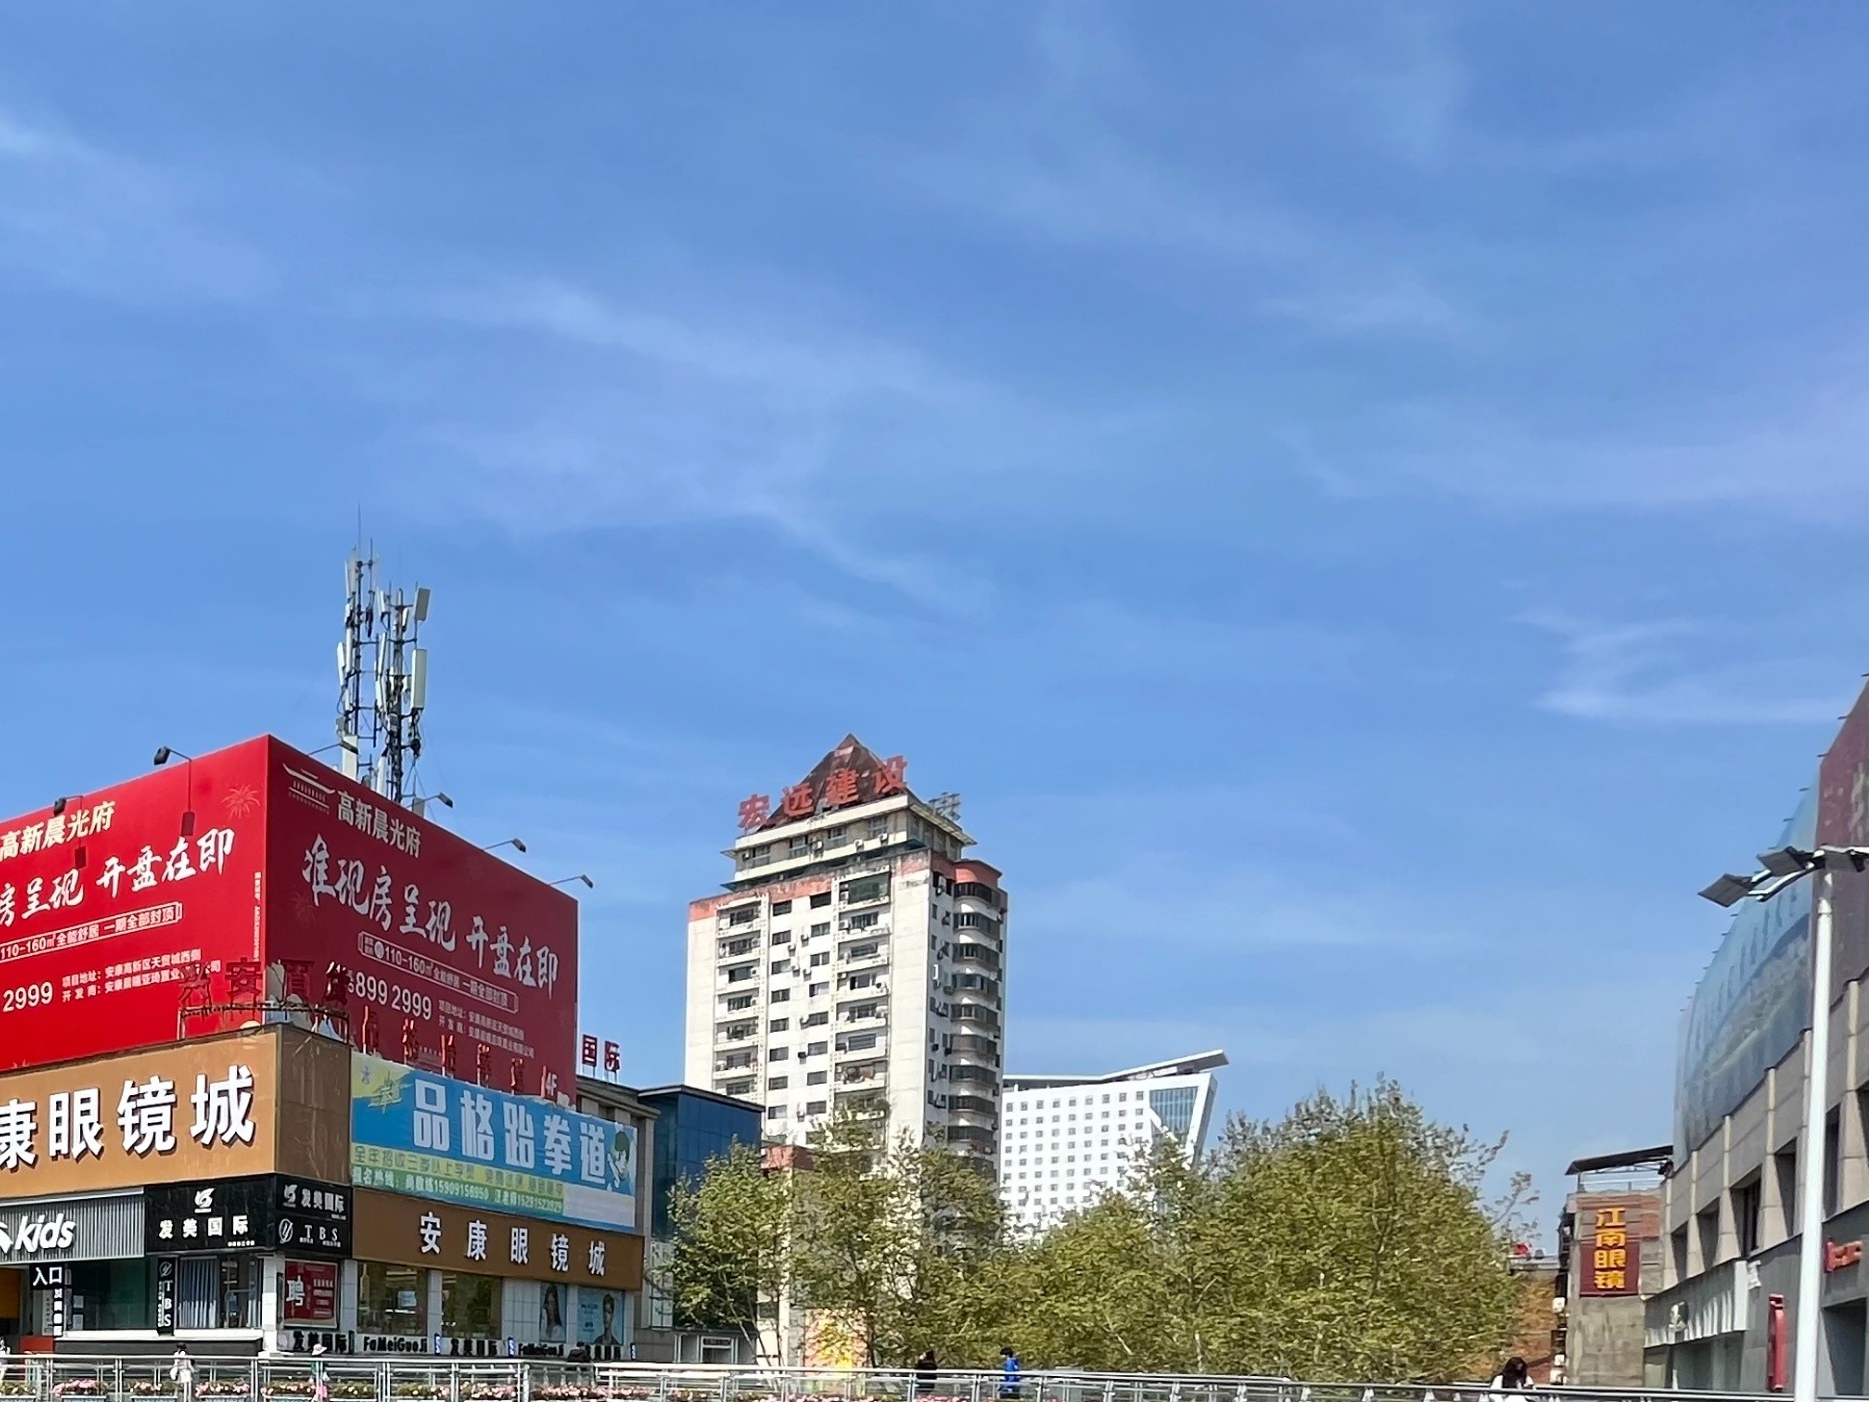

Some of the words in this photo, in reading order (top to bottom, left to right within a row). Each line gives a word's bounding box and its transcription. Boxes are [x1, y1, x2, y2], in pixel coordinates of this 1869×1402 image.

[738, 755, 908, 829] 宏远建设
[338, 790, 421, 858] 高新晨光府
[95, 828, 236, 898] 开盘在即
[302, 834, 456, 952] 准现房呈现
[465, 914, 559, 1000] 开盘在即
[3, 982, 54, 1013] 2999
[355, 972, 388, 1006] 899
[391, 984, 432, 1022] 2999
[582, 1034, 621, 1073] 国际
[412, 1078, 607, 1185] 品格跆拳道
[301, 1188, 345, 1213] 发美国际
[15, 1213, 78, 1253] kids
[158, 1215, 249, 1240] 发美国际
[419, 1211, 606, 1277] 安康眼镜城
[1593, 1207, 1627, 1290] 江南眼镜
[32, 1266, 63, 1287] 入口
[286, 1275, 305, 1307] 聘
